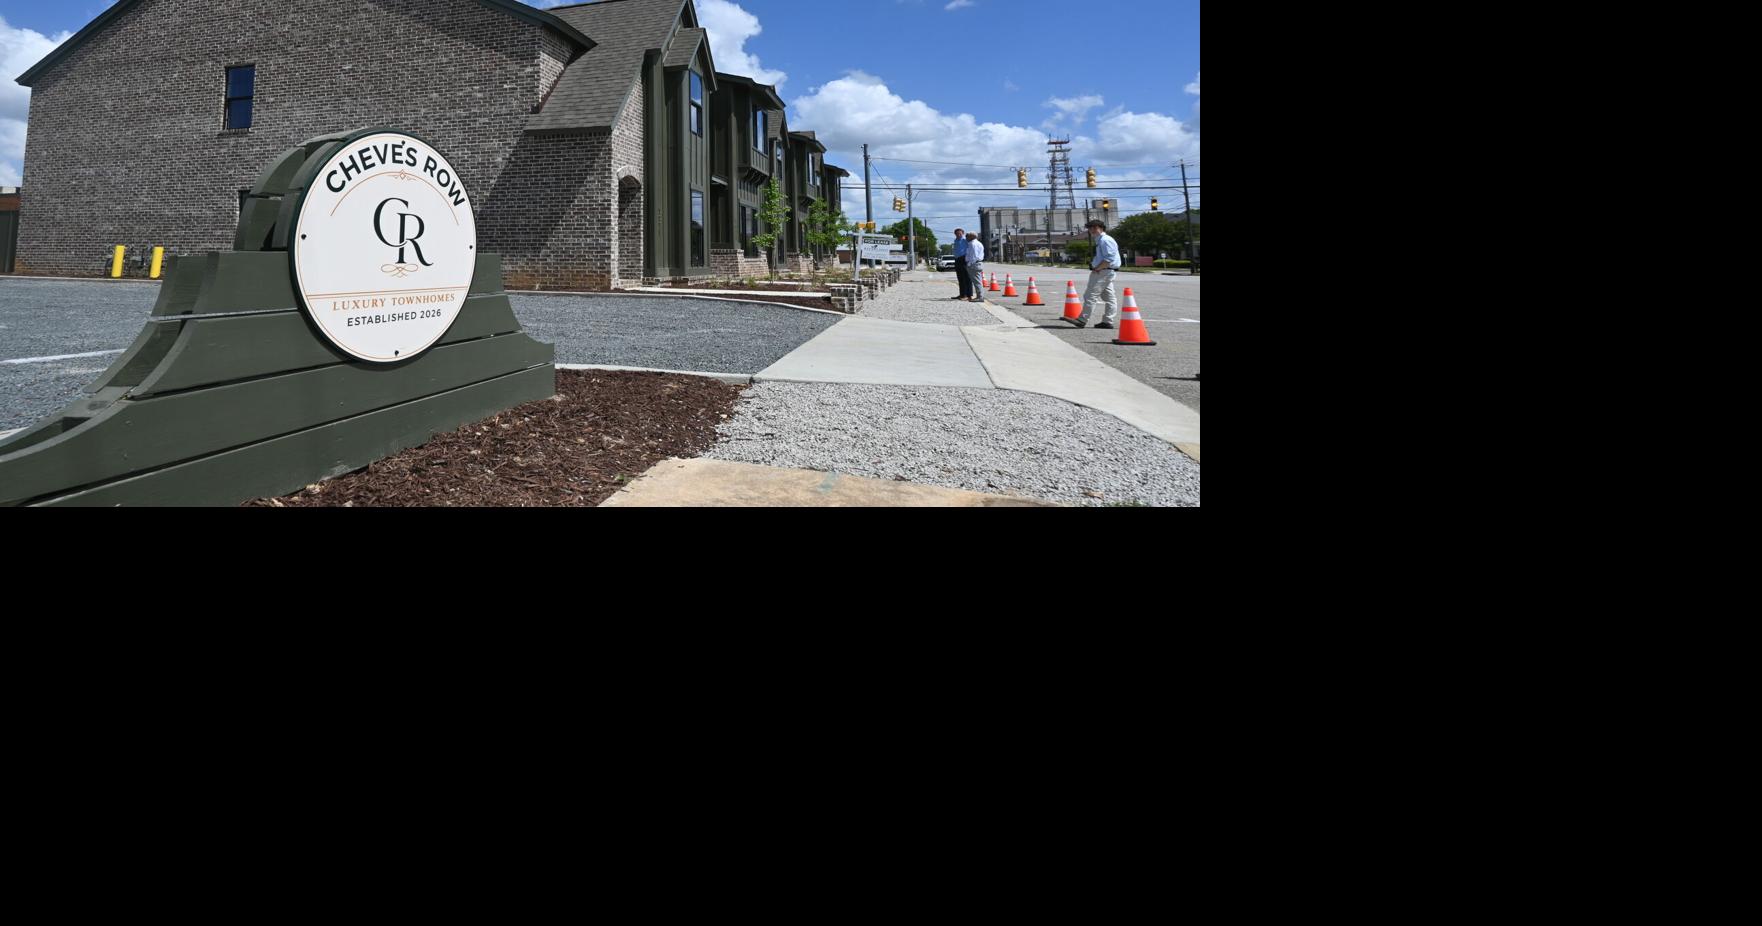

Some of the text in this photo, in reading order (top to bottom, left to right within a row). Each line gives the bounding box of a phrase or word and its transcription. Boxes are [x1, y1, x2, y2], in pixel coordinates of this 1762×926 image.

[326, 142, 465, 207] CHEVE'S ROW
[373, 197, 434, 267] CR
[333, 293, 455, 311] LUXURY TOWNHOMES
[347, 308, 442, 327] ESTABLISHED 2026
